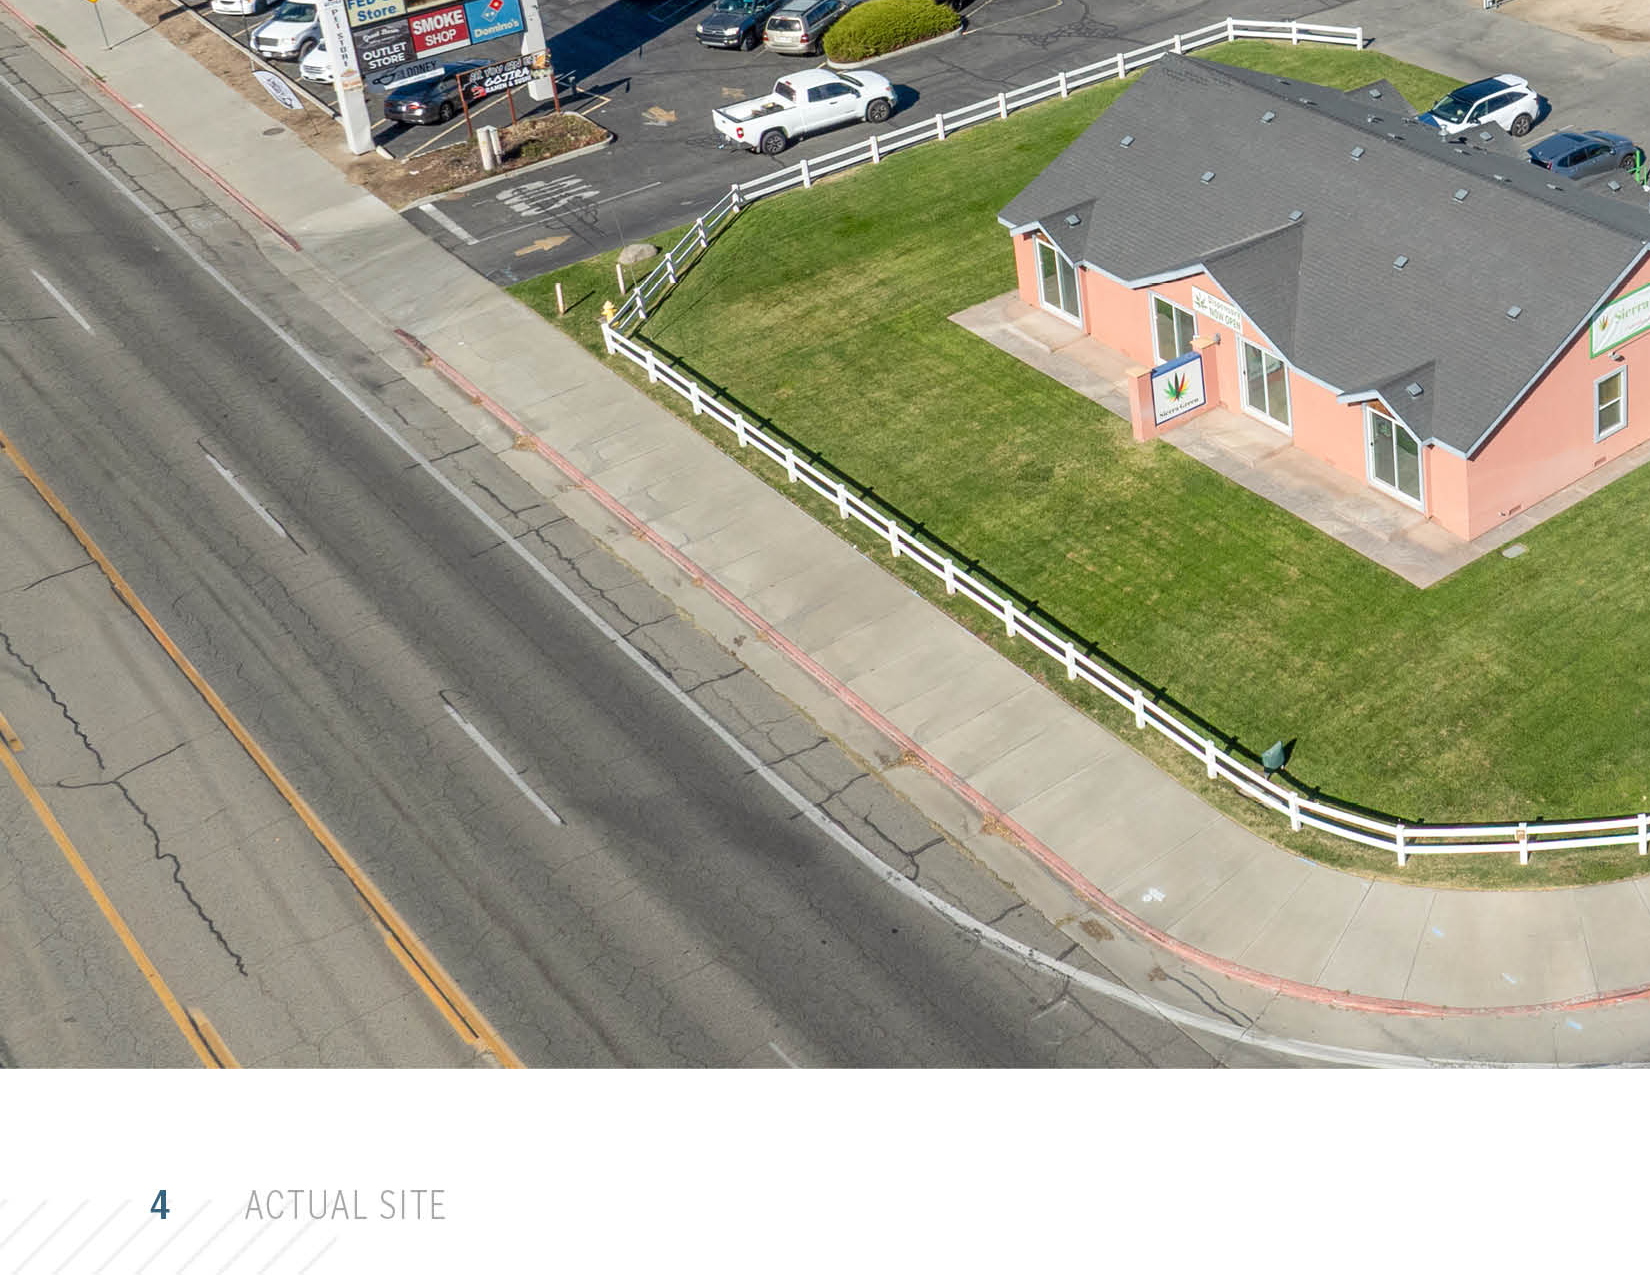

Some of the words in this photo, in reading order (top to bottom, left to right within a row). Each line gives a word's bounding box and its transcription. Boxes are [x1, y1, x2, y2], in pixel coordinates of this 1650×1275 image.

[357, 3, 397, 22] Store
[411, 8, 465, 36] SMOKE
[424, 28, 457, 47] SHOP
[472, 18, 520, 38] Domino's
[362, 40, 408, 61] OUTLET
[367, 52, 406, 70] STORE
